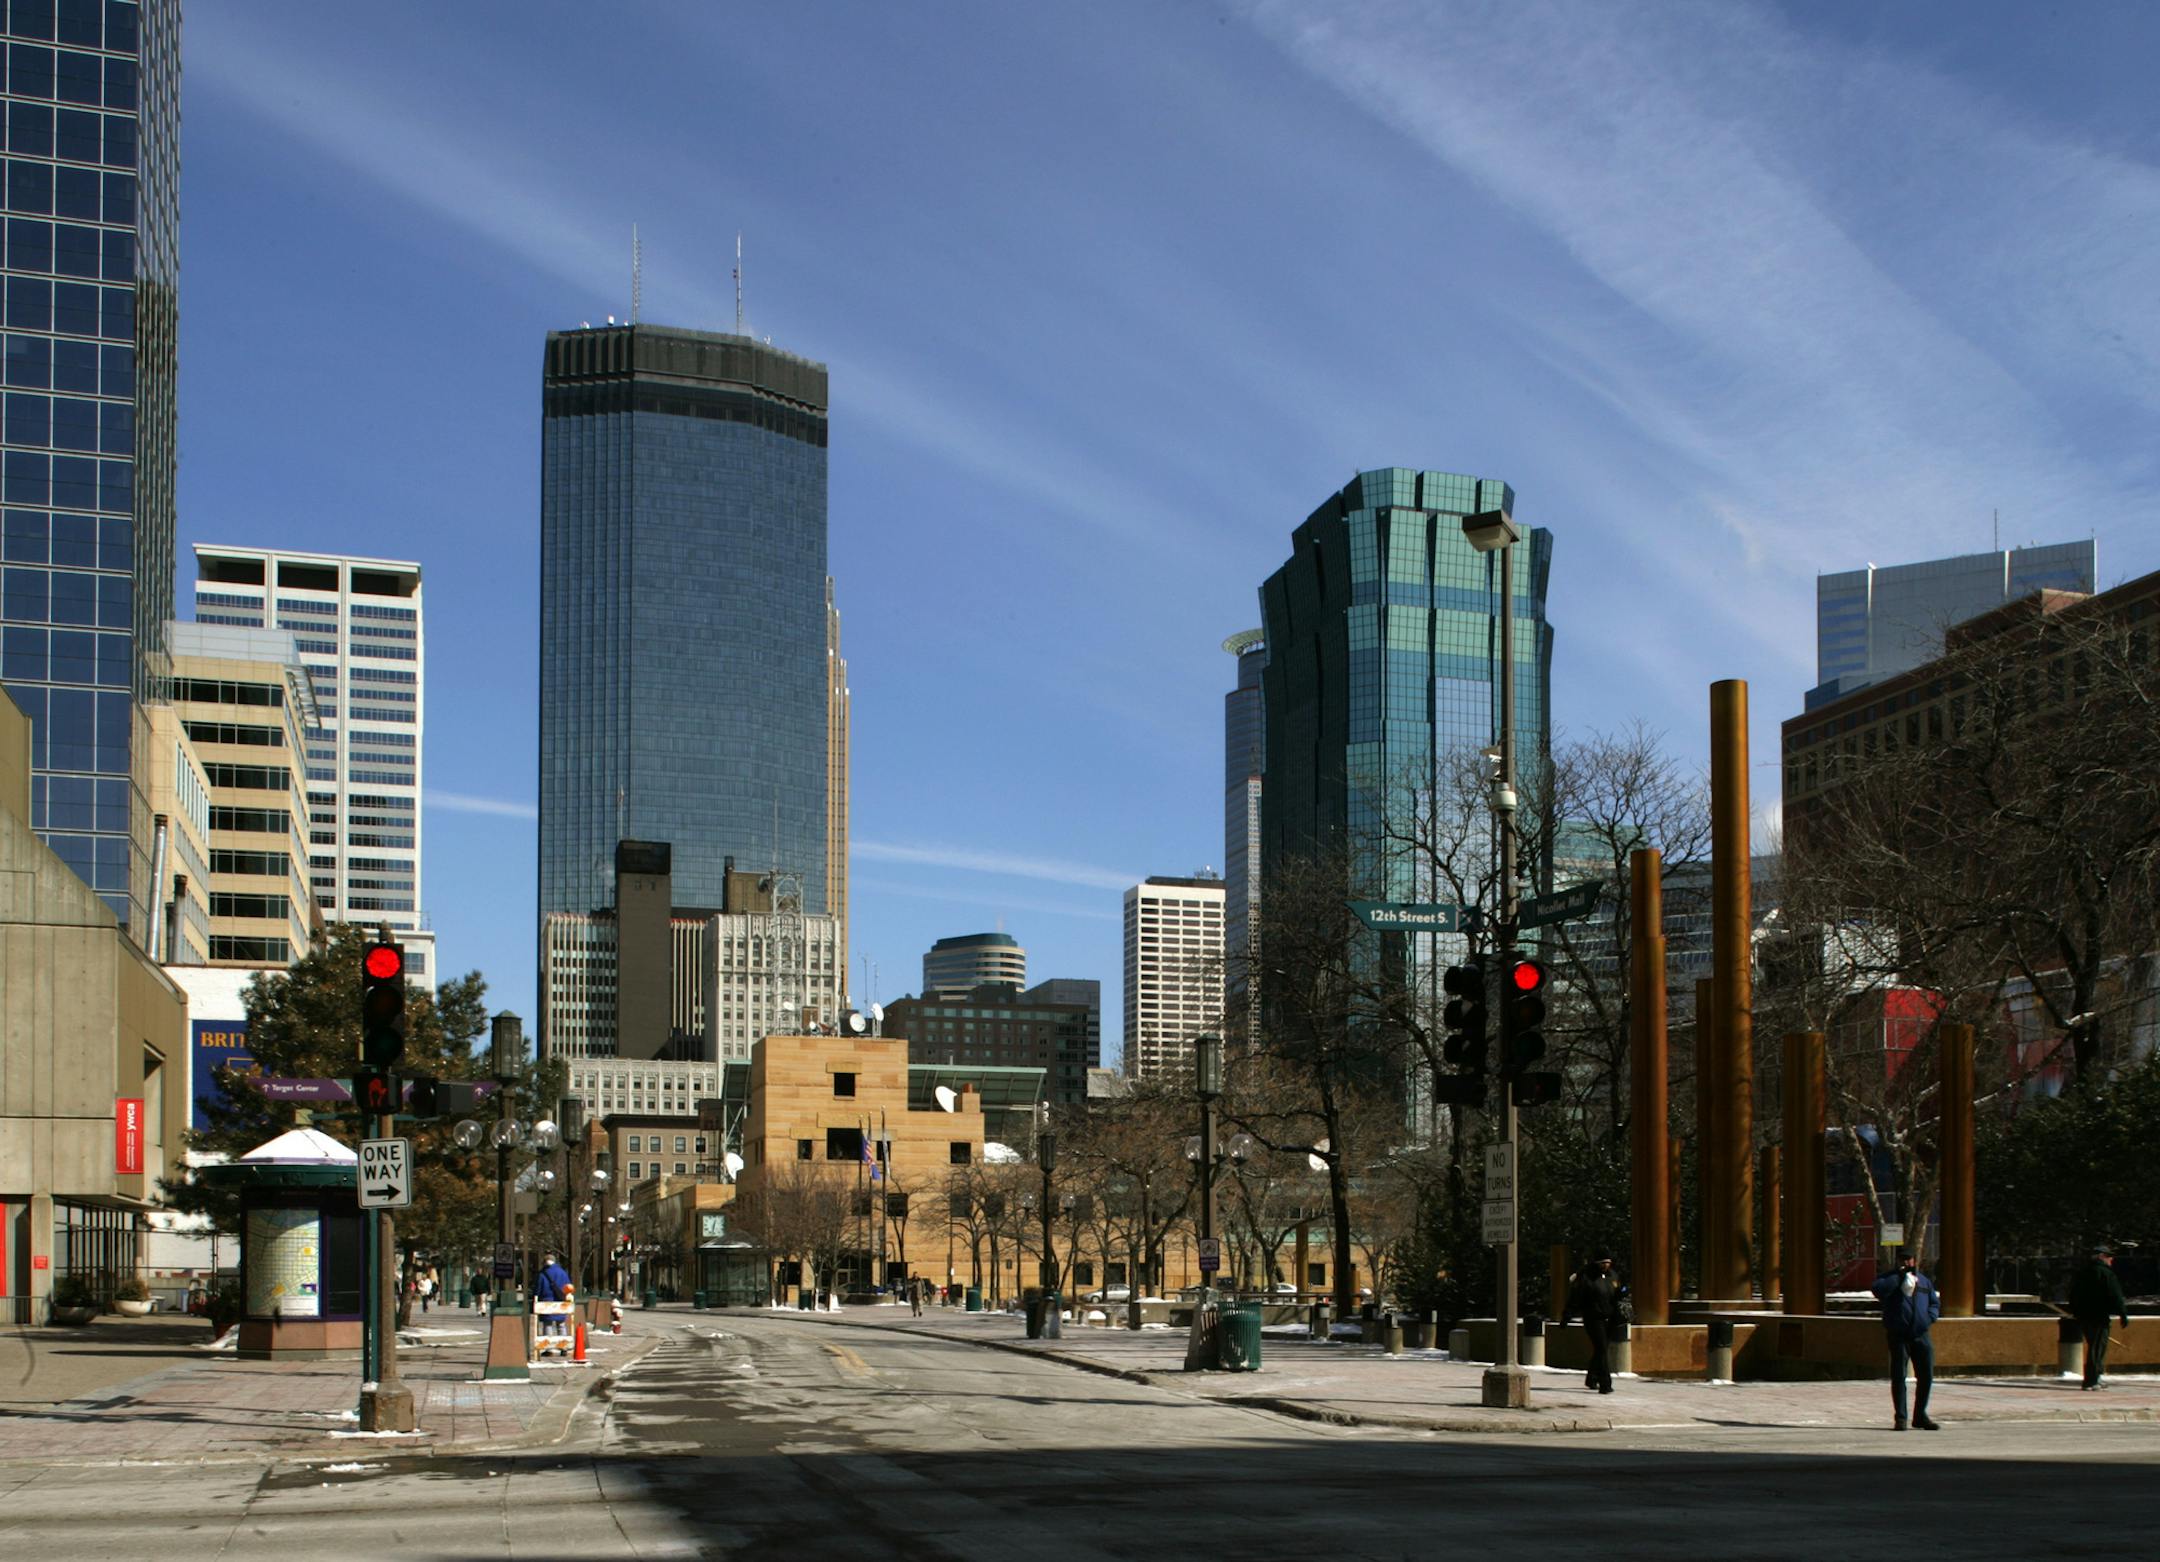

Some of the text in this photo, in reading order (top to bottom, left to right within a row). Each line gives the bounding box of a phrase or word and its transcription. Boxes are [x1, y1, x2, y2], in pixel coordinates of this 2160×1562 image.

[1370, 909, 1449, 924] 12th Street S.
[272, 1084, 319, 1093] Target Center
[364, 1145, 400, 1161] ONE
[1492, 1152, 1505, 1168] NO
[364, 1164, 402, 1180] WAY
[1487, 1175, 1512, 1191] TURNS
